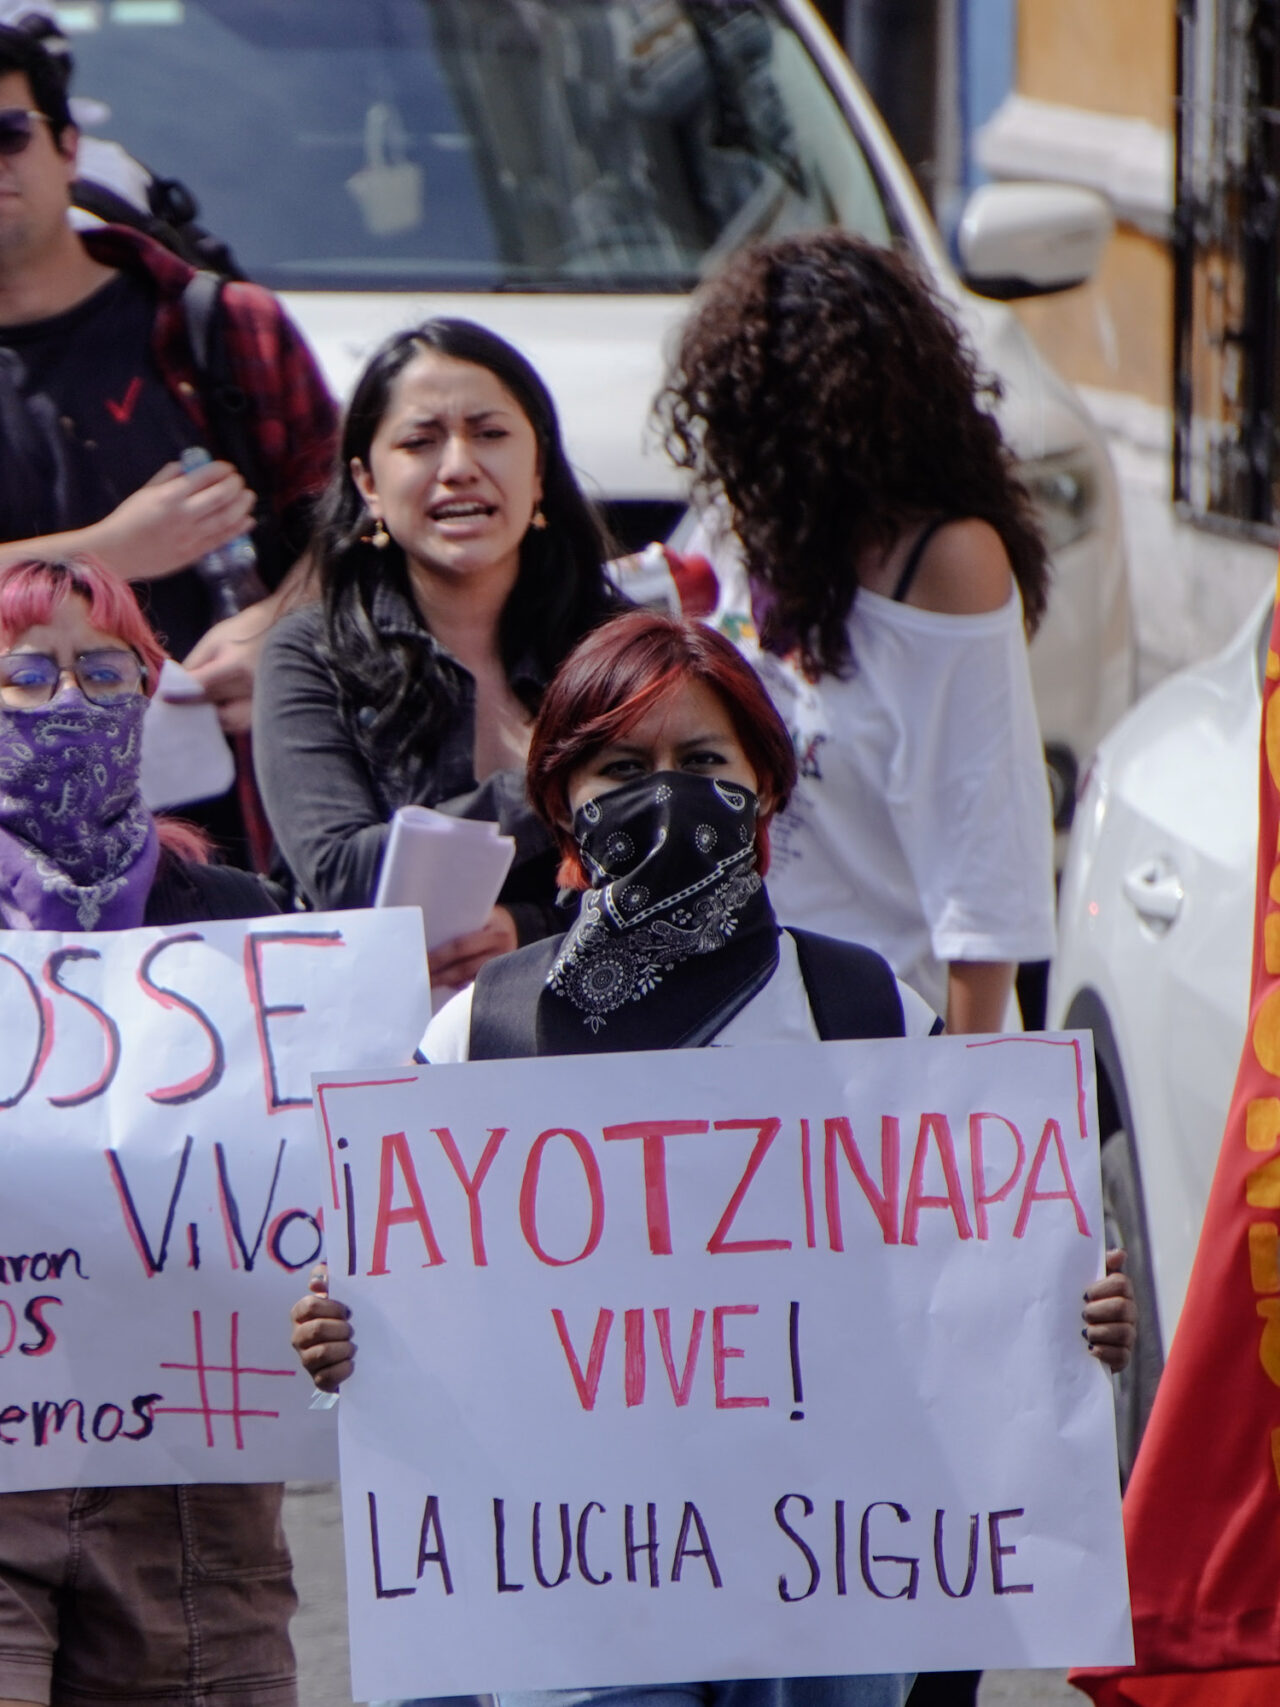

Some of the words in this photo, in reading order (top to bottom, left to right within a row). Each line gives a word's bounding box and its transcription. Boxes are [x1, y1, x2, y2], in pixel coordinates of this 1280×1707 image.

[368, 1491, 454, 1601] LA
[493, 1496, 723, 1595] LUCHA
[774, 1492, 1035, 1603] SIGUE
